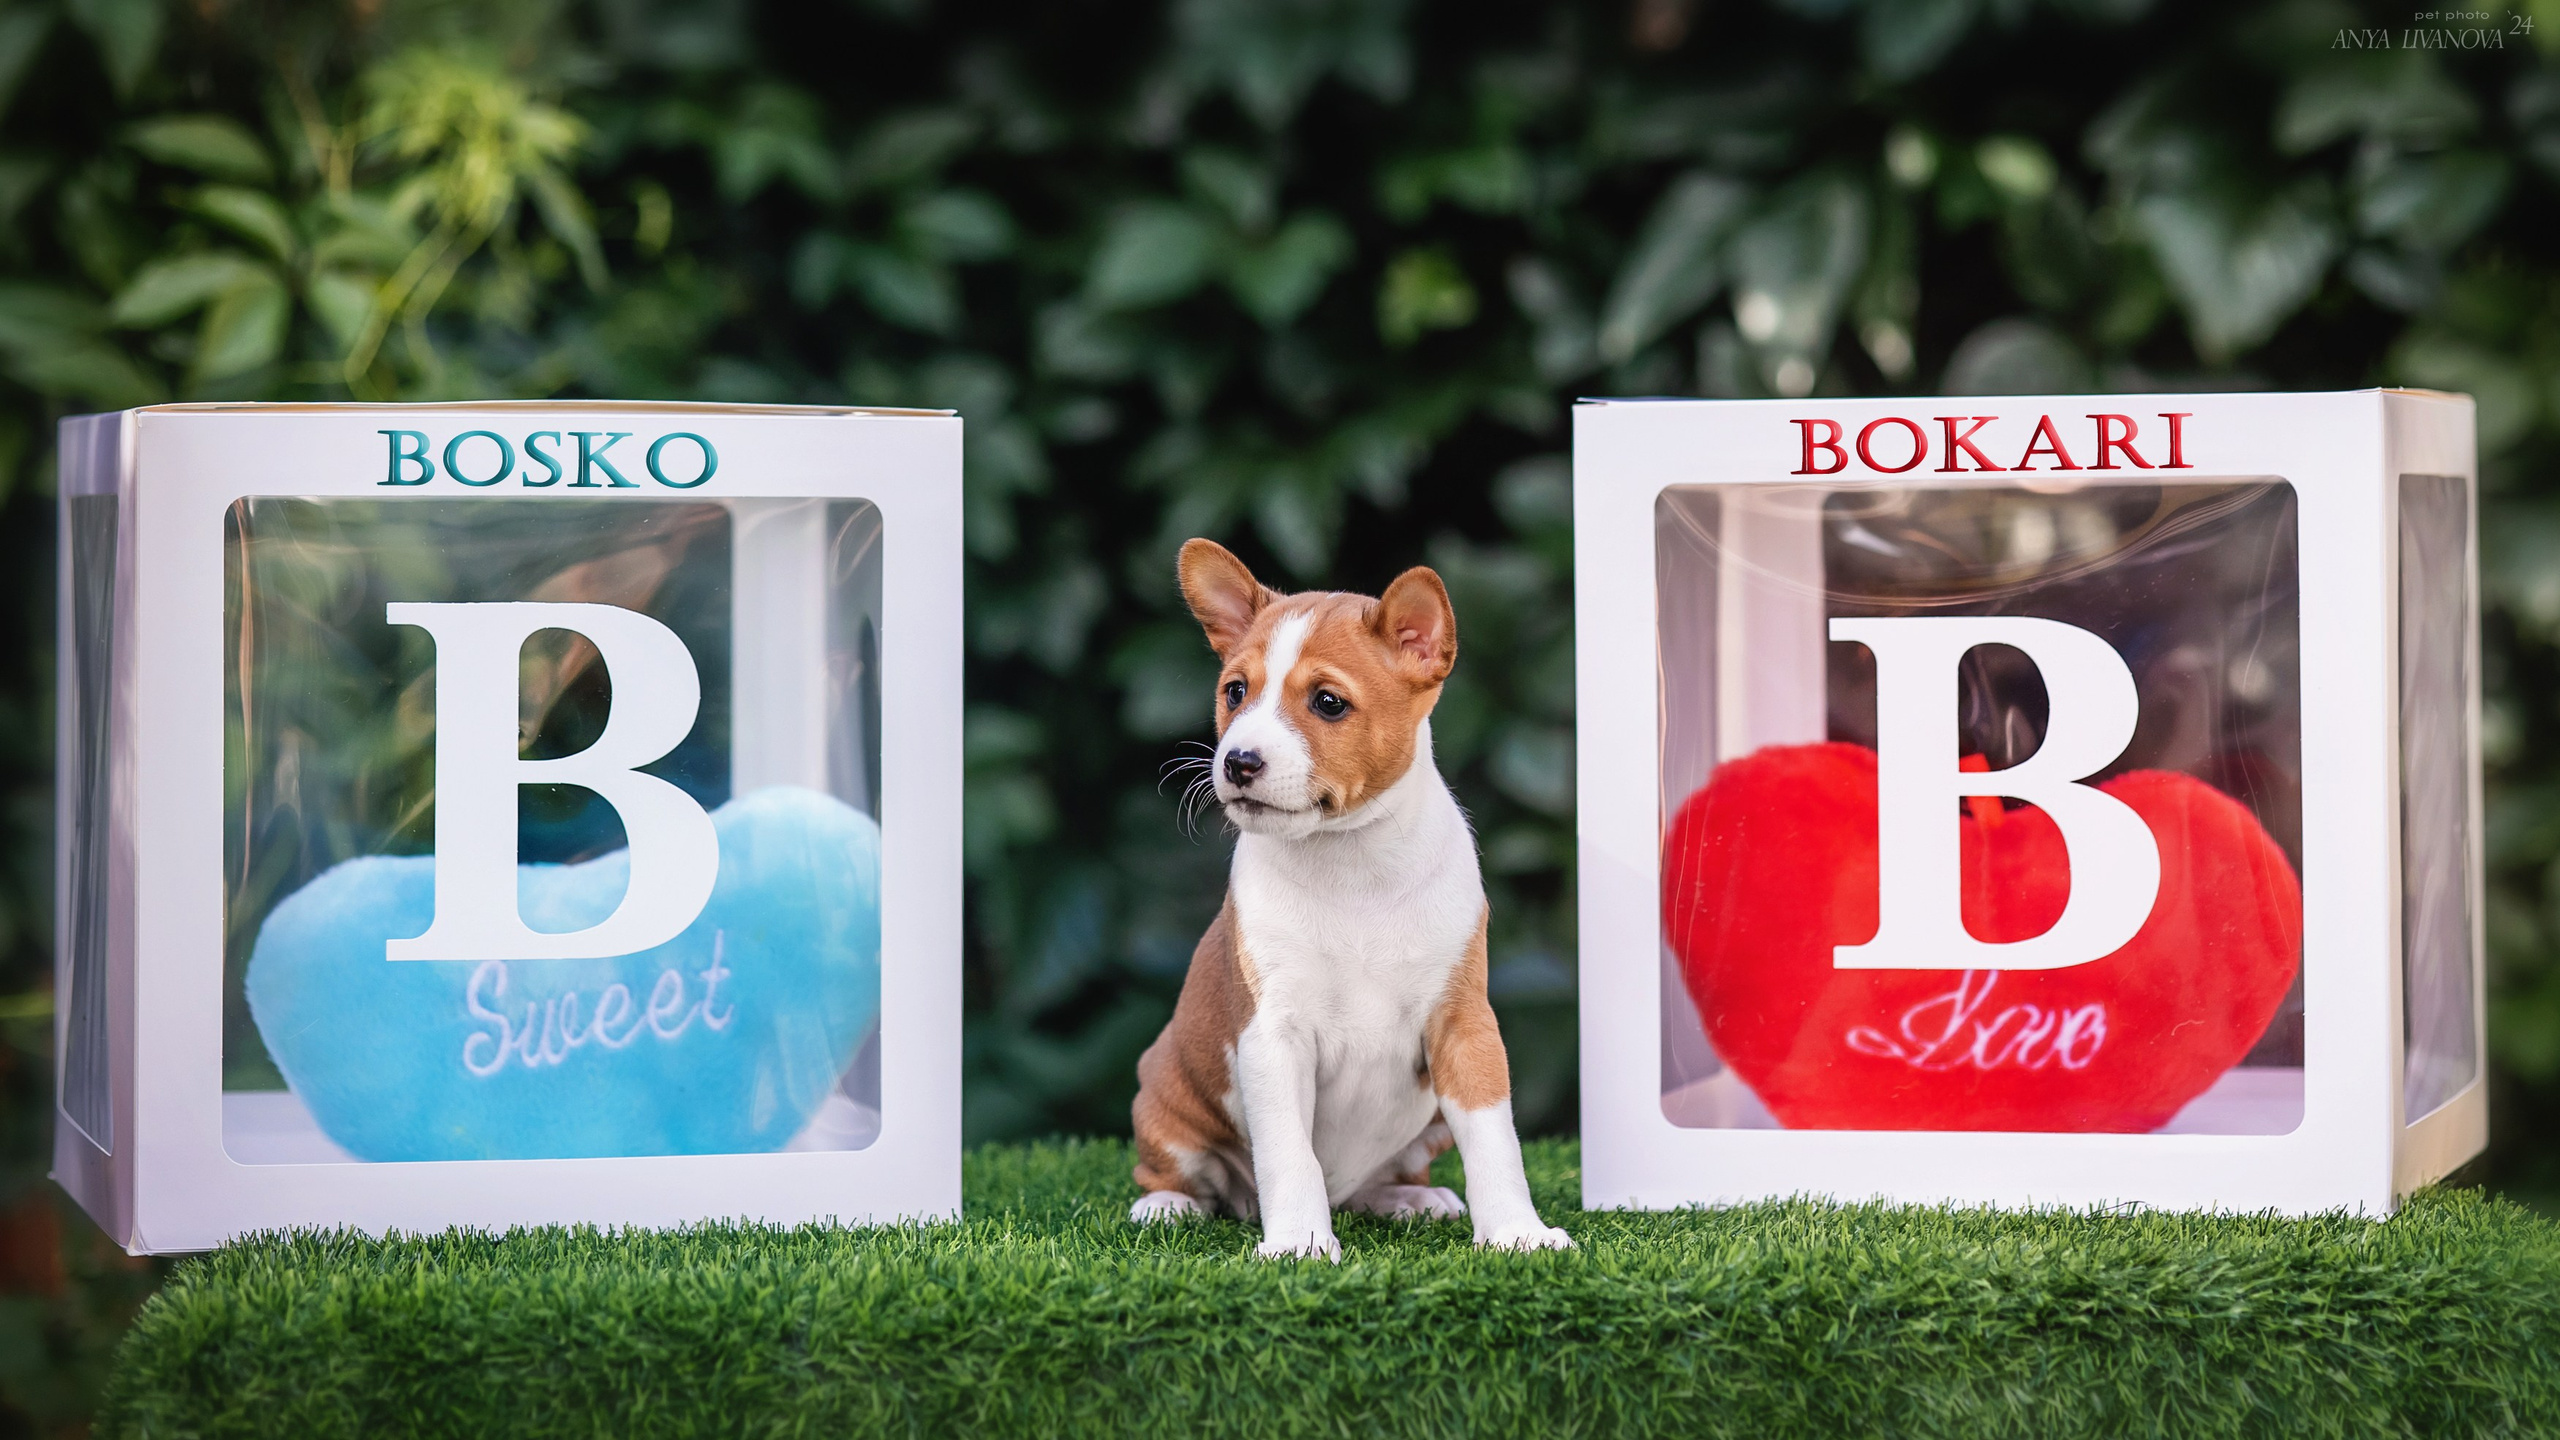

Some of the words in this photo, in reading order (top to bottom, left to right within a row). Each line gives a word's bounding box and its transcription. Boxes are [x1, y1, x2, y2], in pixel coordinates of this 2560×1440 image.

[377, 429, 719, 489] BOSKO
[1790, 412, 2194, 475] BOKARI
[386, 601, 720, 961] B
[1828, 615, 2162, 970] B
[462, 928, 735, 1077] Sweet
[1845, 969, 2107, 1071] Love
